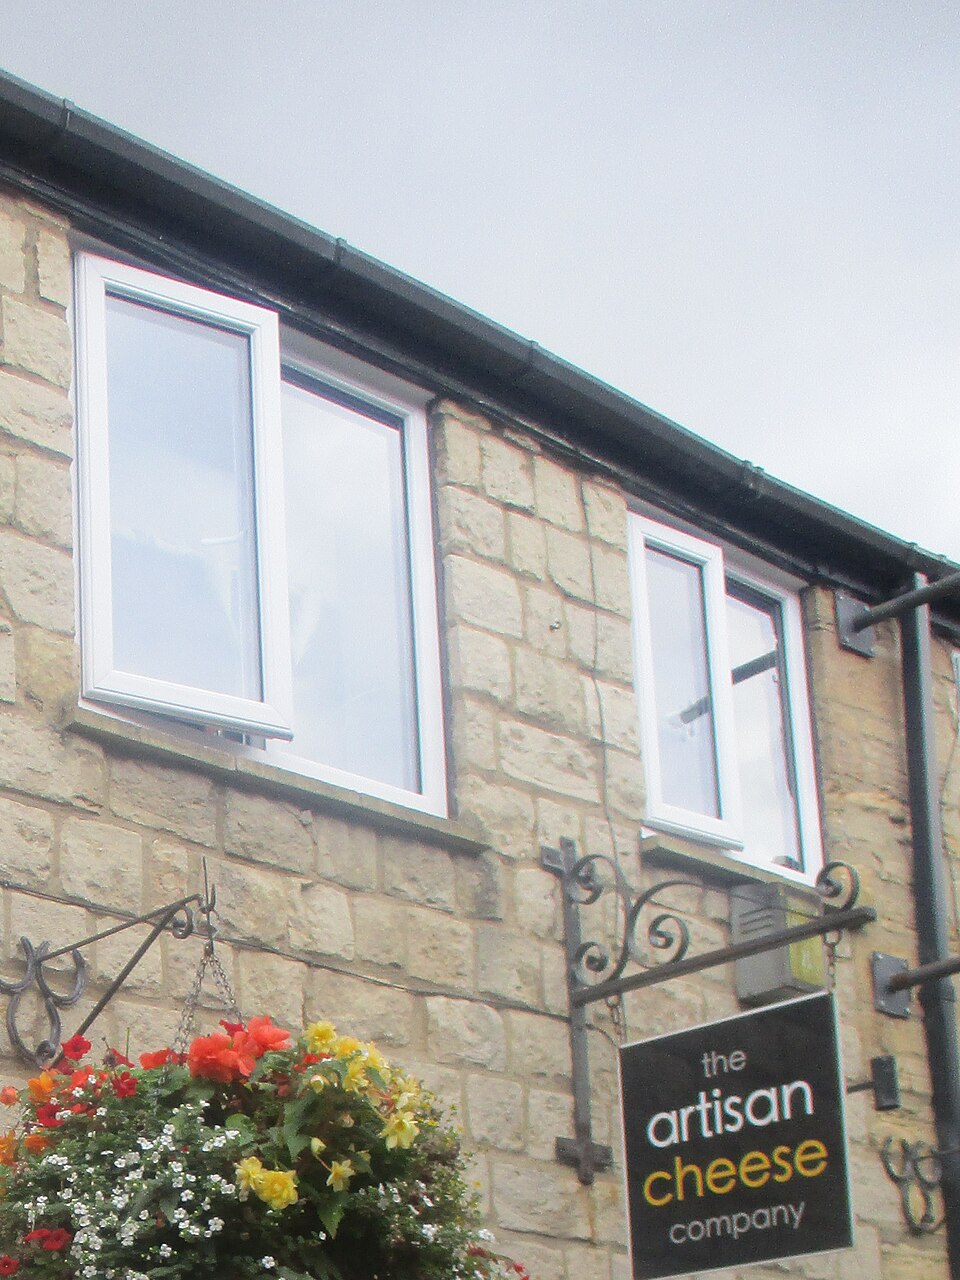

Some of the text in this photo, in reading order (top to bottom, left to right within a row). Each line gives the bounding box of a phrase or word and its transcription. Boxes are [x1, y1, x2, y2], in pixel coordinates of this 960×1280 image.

[701, 1049, 747, 1078] the
[646, 1080, 814, 1148] artisan
[643, 1139, 828, 1206] cheese
[669, 1201, 805, 1244] company
